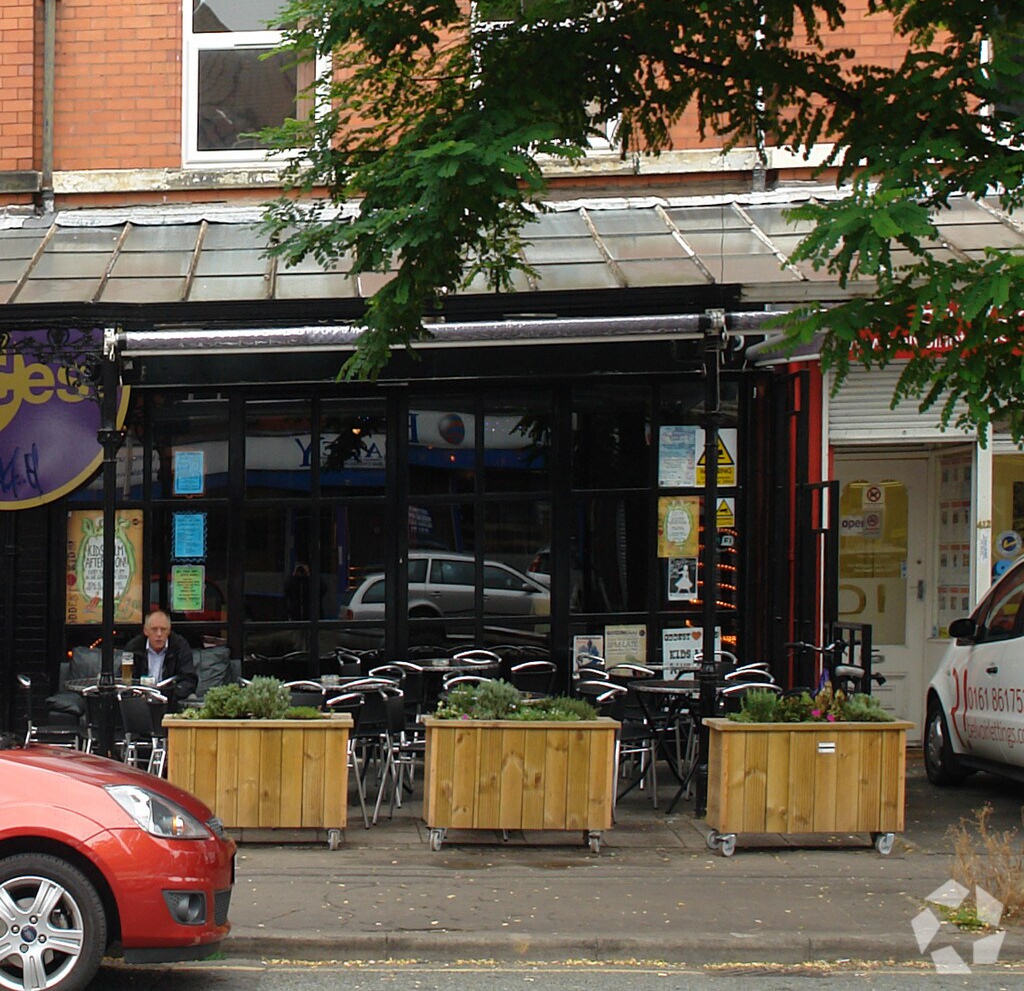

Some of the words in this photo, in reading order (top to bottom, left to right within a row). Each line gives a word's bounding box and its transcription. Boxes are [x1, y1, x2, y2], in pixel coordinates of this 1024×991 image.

[669, 649, 691, 659] KIDS
[968, 687, 989, 711] 0161
[992, 688, 1024, 713] 86175
